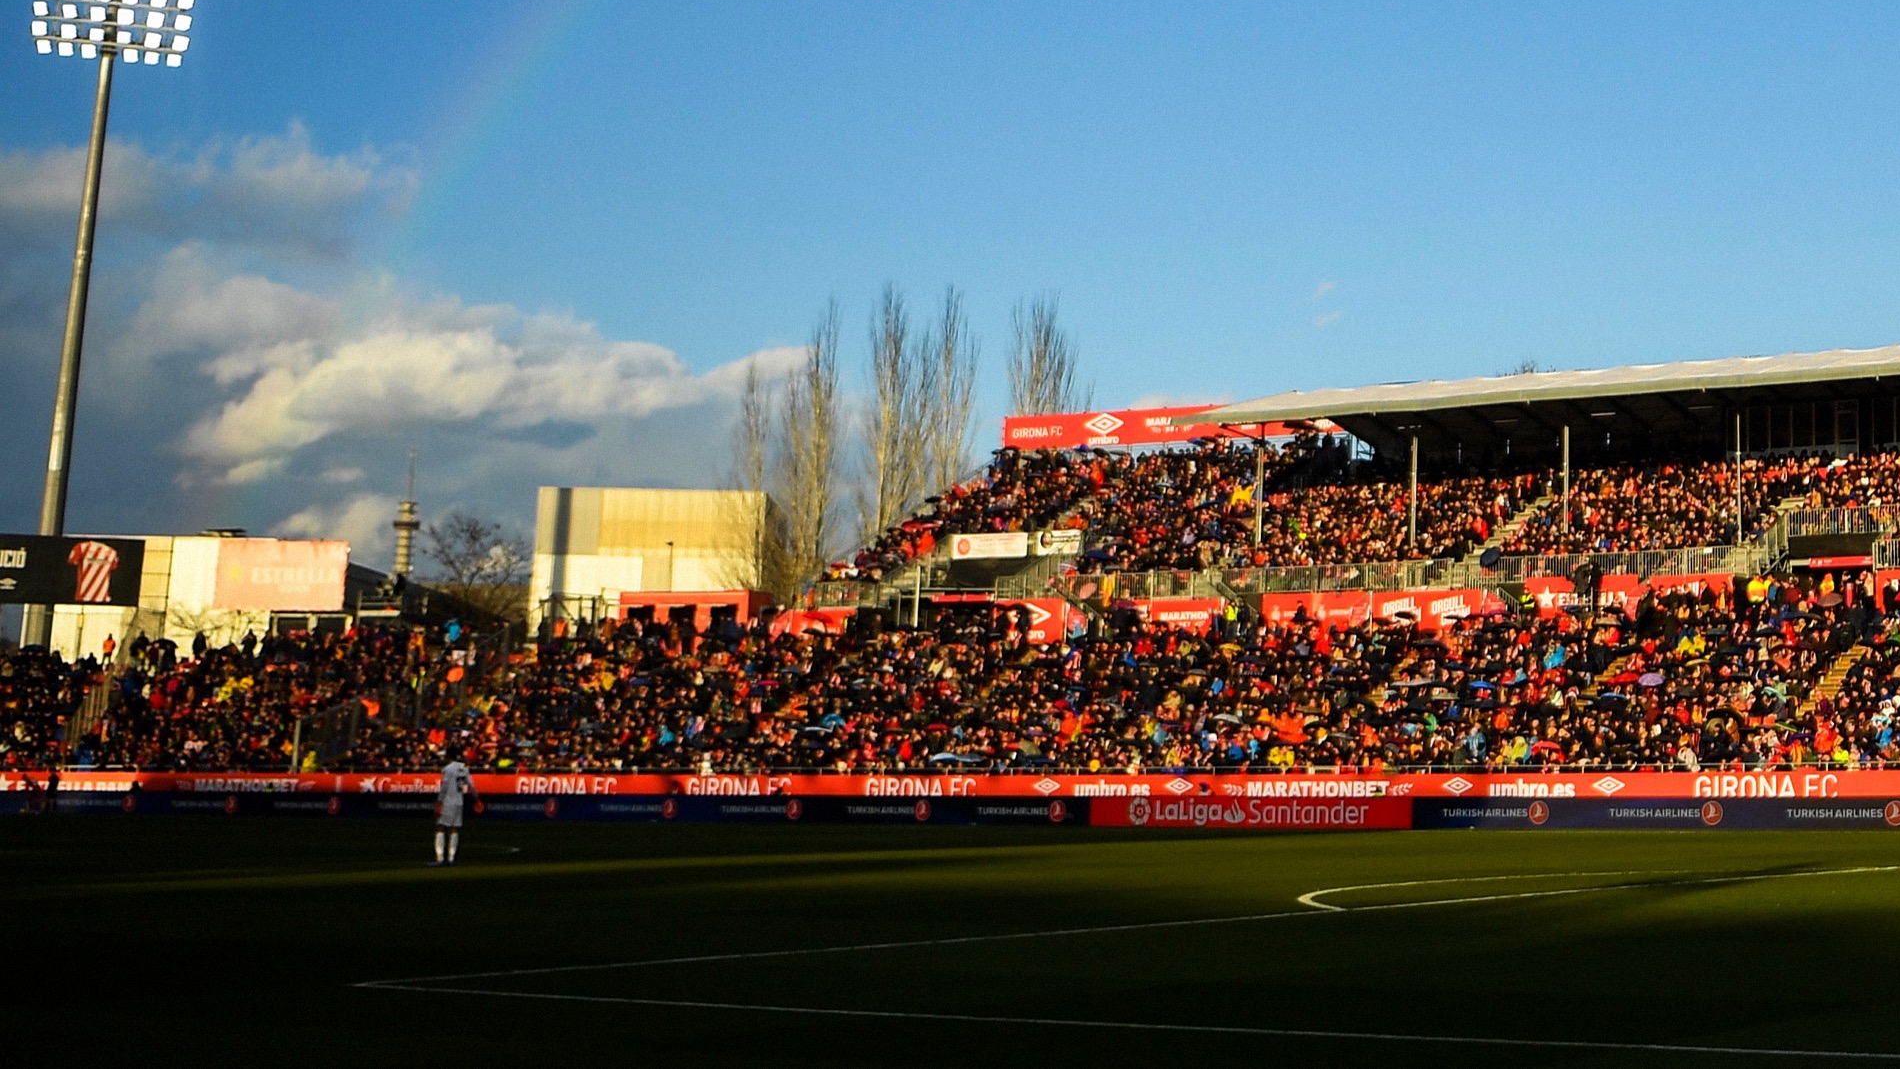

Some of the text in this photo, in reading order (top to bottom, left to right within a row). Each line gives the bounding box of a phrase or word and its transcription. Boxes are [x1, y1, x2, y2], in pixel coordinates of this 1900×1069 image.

[1012, 425, 1063, 438] GIRONA FC
[1088, 435, 1119, 444] umbro
[516, 777, 617, 795] GIRONA FC
[688, 778, 792, 796] GIRONA FC
[865, 777, 976, 797] GIRONA FC
[1247, 781, 1390, 798] MARATHONBET
[1694, 774, 1838, 798] GIRONA FC
[1155, 797, 1370, 824] LaLiga Santander
[1443, 808, 1529, 818] TURKISH AIRLINES
[1609, 808, 1700, 818] TURKISH AIRLINES
[1787, 808, 1884, 819] TURKISH AIRLINES
